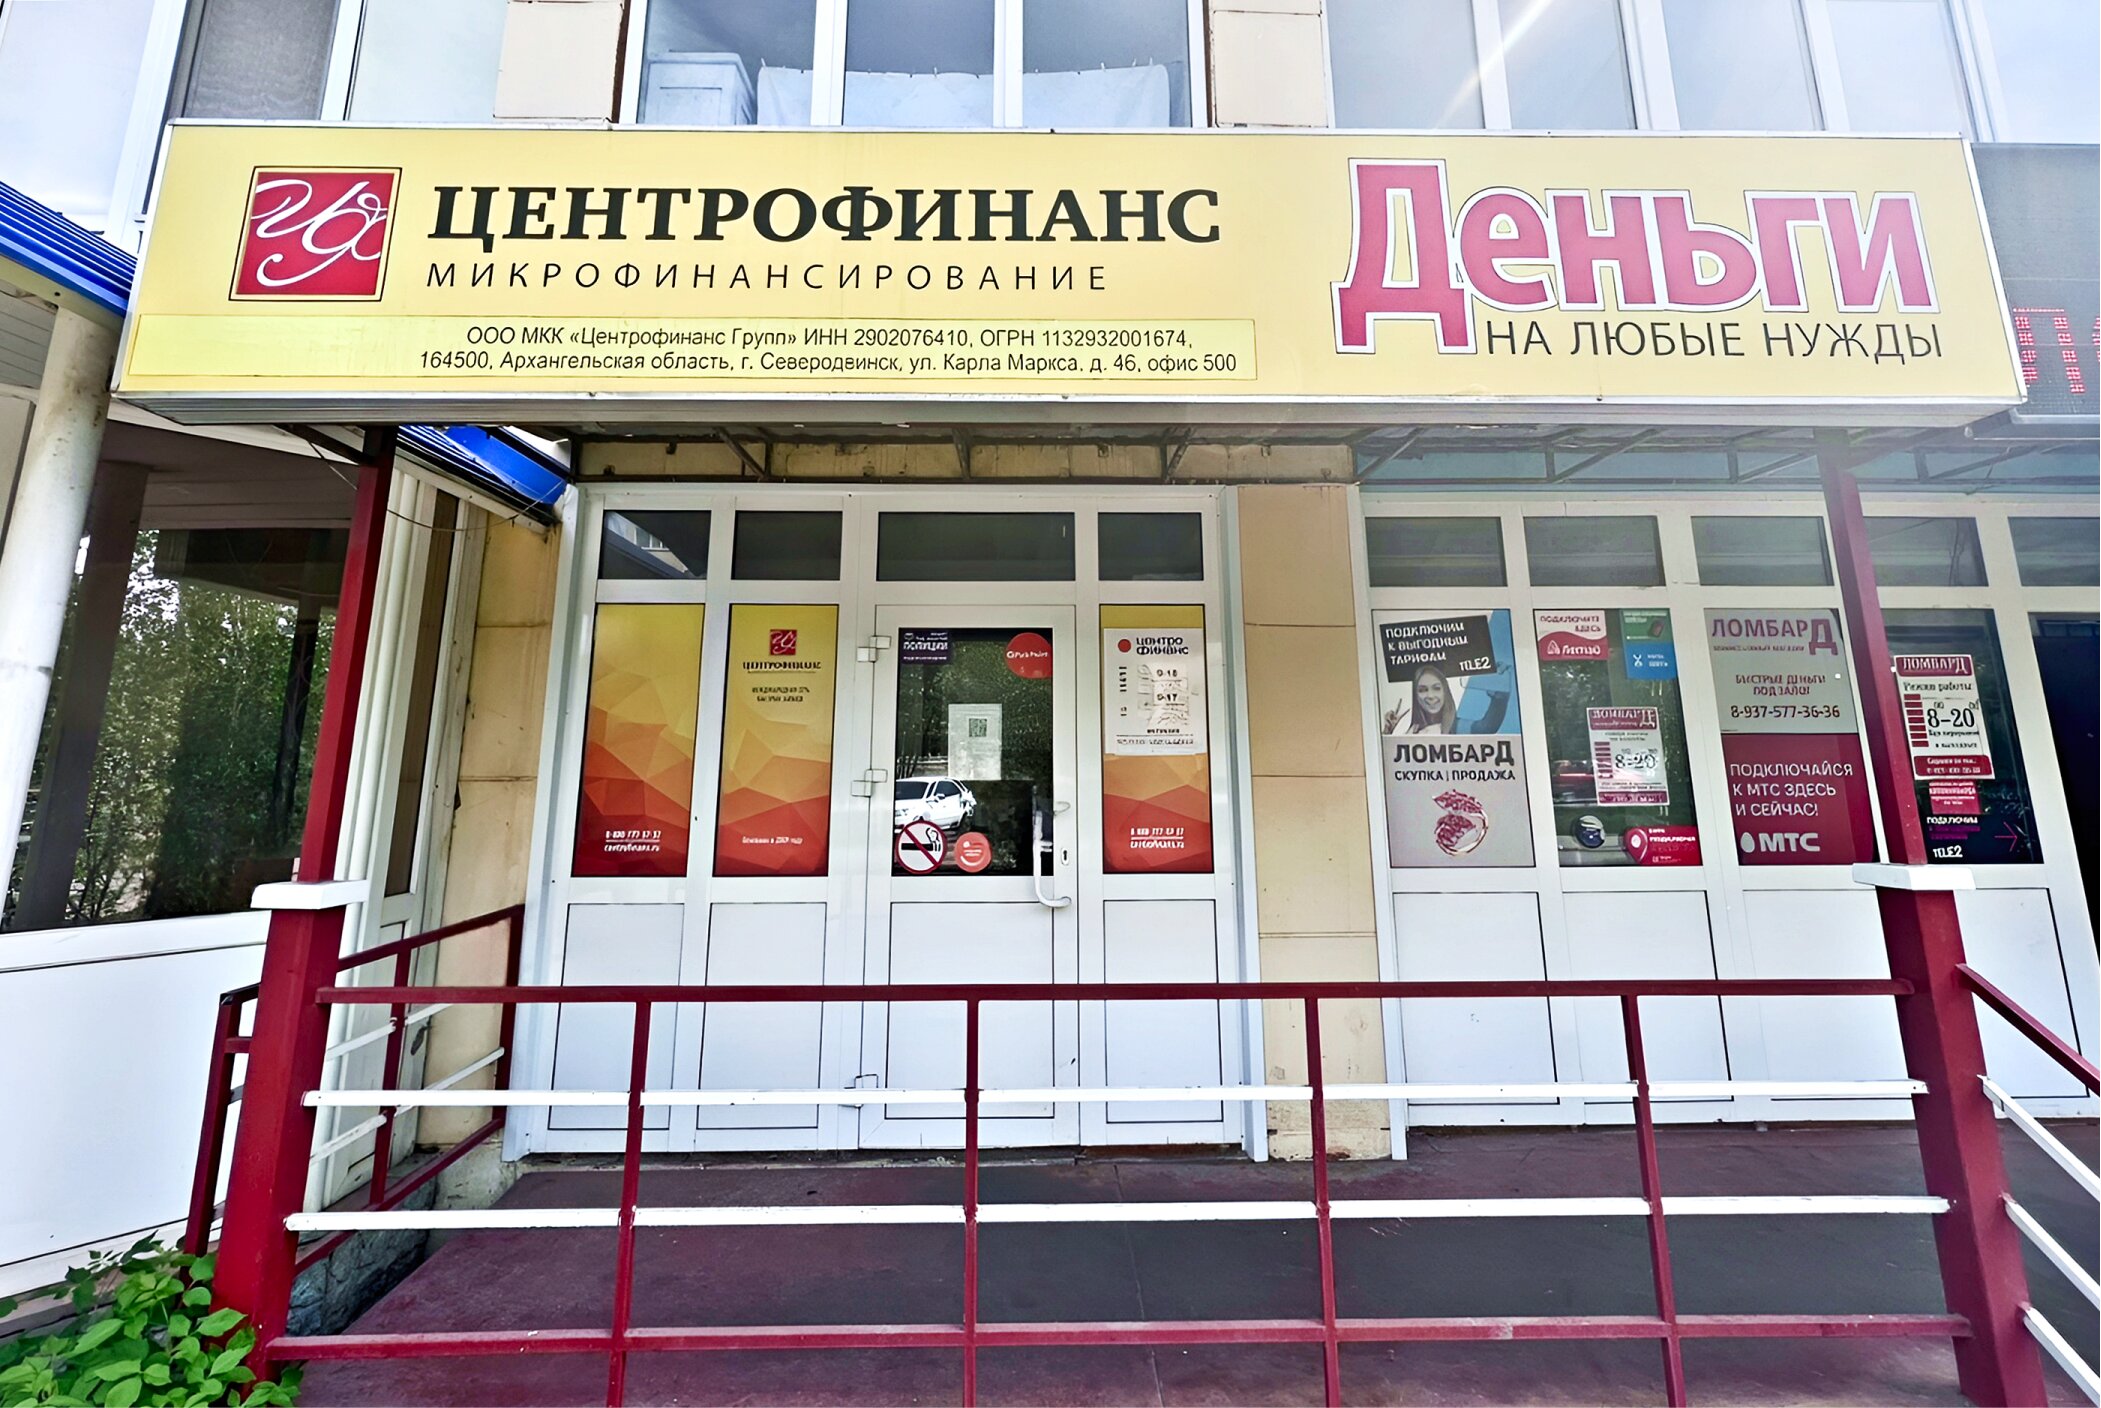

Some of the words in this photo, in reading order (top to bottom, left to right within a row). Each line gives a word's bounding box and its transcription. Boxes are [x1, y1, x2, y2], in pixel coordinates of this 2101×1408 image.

[427, 186, 1220, 252] ЦЕНТРОФИНАНС
[1329, 157, 1942, 355] Деньги
[426, 262, 1107, 291] МИКРОФИНАНСИРОВАНИЕ
[467, 326, 516, 345] ООО
[521, 327, 564, 345] МКК
[569, 327, 726, 350] «Центрофинанс
[731, 328, 797, 351] Групп»
[803, 328, 848, 347] ИНН
[854, 329, 974, 349] 2902076410,
[980, 329, 1035, 347] ОГРН
[1042, 330, 1194, 349] 1132932001674,
[1487, 320, 1553, 356] НА
[1570, 320, 1746, 358] ЛЮБЫЕ
[1763, 321, 1943, 365] НУЖДЫ
[420, 351, 494, 372] 164500,
[500, 352, 644, 372] Архангельская
[651, 352, 735, 373] область,
[741, 355, 754, 370] г.
[760, 353, 902, 373] Северодвинск,
[909, 355, 937, 375] ул.
[943, 354, 1000, 375] Карла
[1090, 357, 1108, 374] д.
[1147, 355, 1198, 374] офис
[1203, 355, 1237, 371] 500
[1712, 618, 1839, 655] ЛОМБАРД
[1730, 705, 1840, 718] 8-937-577-36-36
[1393, 740, 1515, 767] ЛОМБАРД
[1395, 770, 1444, 781] СКУПКА
[1452, 769, 1516, 781] ПРОДАЖА
[1730, 760, 1854, 778] ПОДКЛЮЧАЙСЯ
[1733, 784, 1743, 796] К
[1747, 784, 1780, 796] МТС
[1784, 783, 1837, 798] ЗДЕСЬ
[1736, 803, 1746, 816] И
[1750, 800, 1819, 816] СЕЙЧАС!
[1758, 832, 1821, 852] МТС
